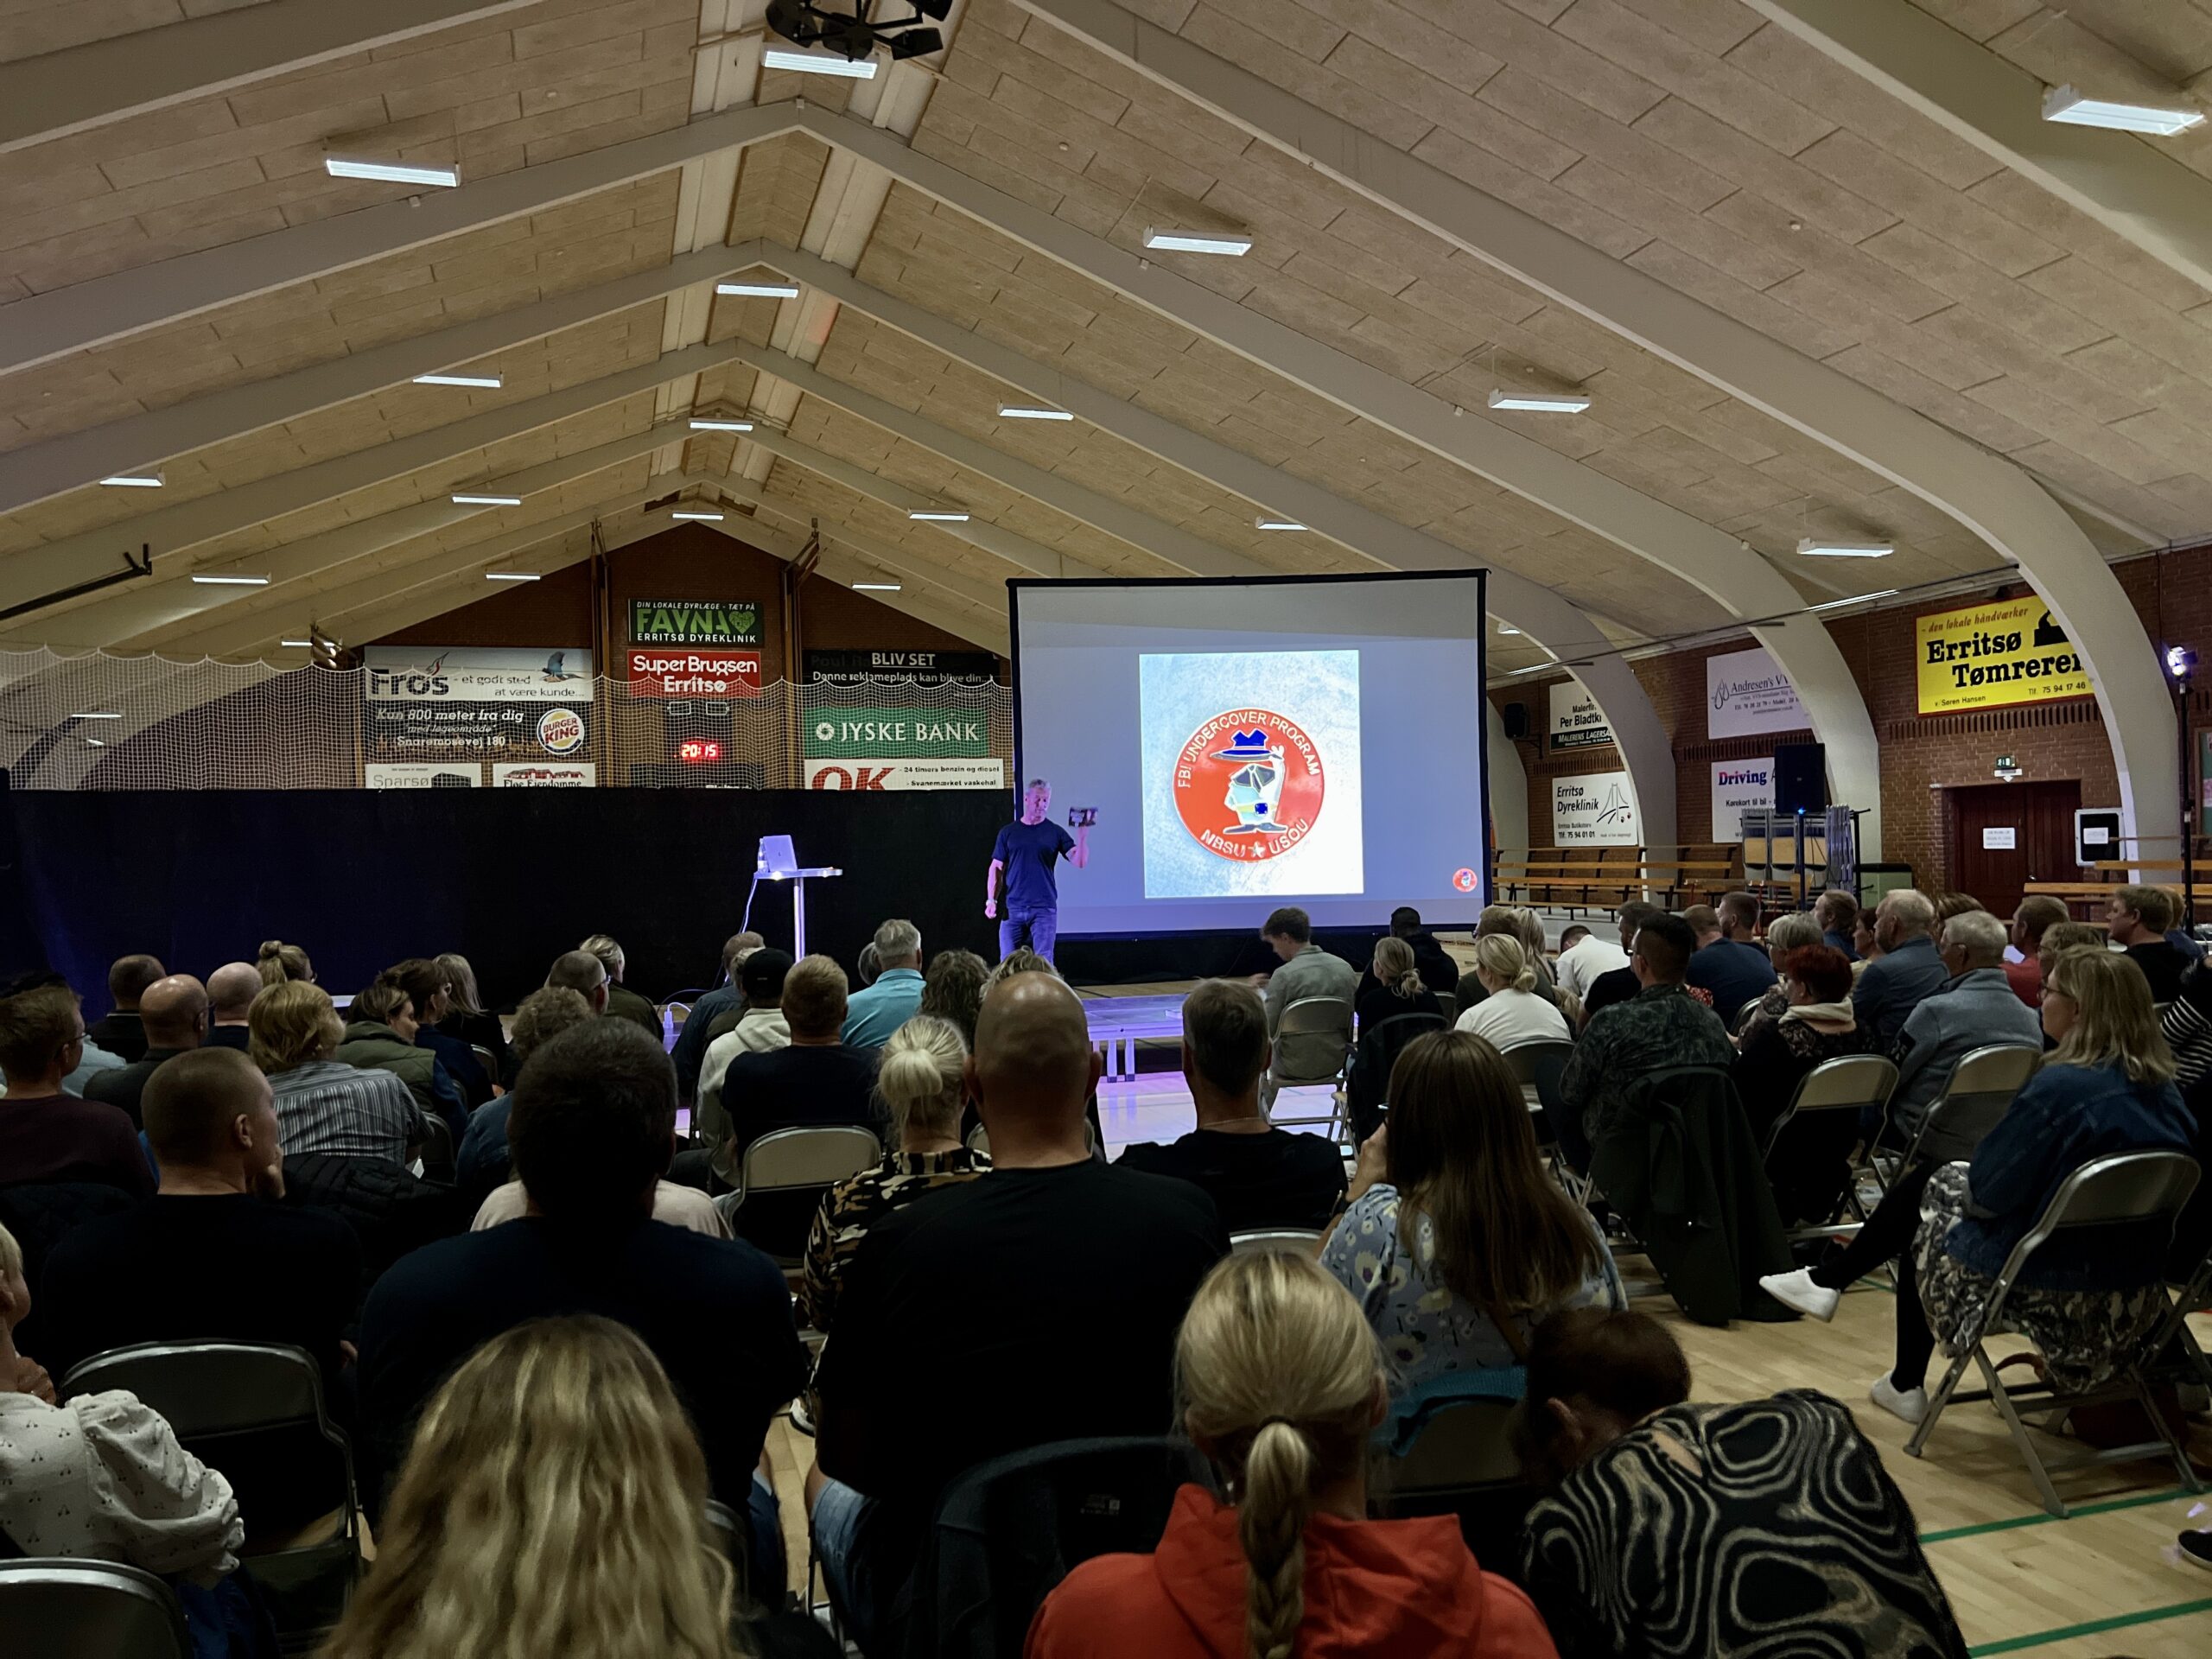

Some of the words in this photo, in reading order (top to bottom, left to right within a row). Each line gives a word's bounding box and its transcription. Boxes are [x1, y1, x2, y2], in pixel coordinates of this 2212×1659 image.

[1929, 622, 1943, 632] den
[1946, 617, 1972, 630] lokale
[1974, 607, 2029, 625] håndværker
[637, 632, 685, 642] ERRITSØ
[690, 633, 757, 643] DYREKLINIK
[1927, 631, 2022, 664] Erritsø
[872, 652, 906, 665] BLIV
[909, 653, 936, 666] SET
[461, 675, 474, 683] et
[476, 675, 504, 685] godt
[506, 675, 531, 684] sted
[664, 675, 728, 693] Erritsø
[813, 671, 847, 682] Denne
[849, 671, 917, 683] reklameplads
[919, 672, 938, 683] kan
[939, 672, 964, 683] blive
[1731, 677, 1774, 693] Andresen's
[494, 688, 506, 696] at
[1961, 695, 1986, 703] Hansen
[376, 708, 404, 720] Kun
[407, 709, 431, 721] 800
[434, 709, 475, 721] meter
[477, 709, 499, 721] fra
[501, 709, 524, 722] dig
[1560, 716, 1573, 728] Per
[543, 717, 578, 734] BURGER
[841, 722, 906, 741] JYSKE
[916, 722, 980, 741] BANK
[486, 735, 506, 746] 180
[544, 725, 580, 744] KING
[1185, 711, 1267, 763] UNDERCOVER
[681, 743, 716, 758] 20:15
[1269, 716, 1321, 776] PROGRAM
[811, 766, 897, 791] OK
[1178, 765, 1192, 788] FBI
[1718, 770, 1767, 785] Driving
[1557, 785, 1584, 798] Erritsø
[1557, 798, 1599, 815] Dyreklinik
[1200, 830, 1246, 857] NBSU
[1268, 818, 1309, 855] USOU
